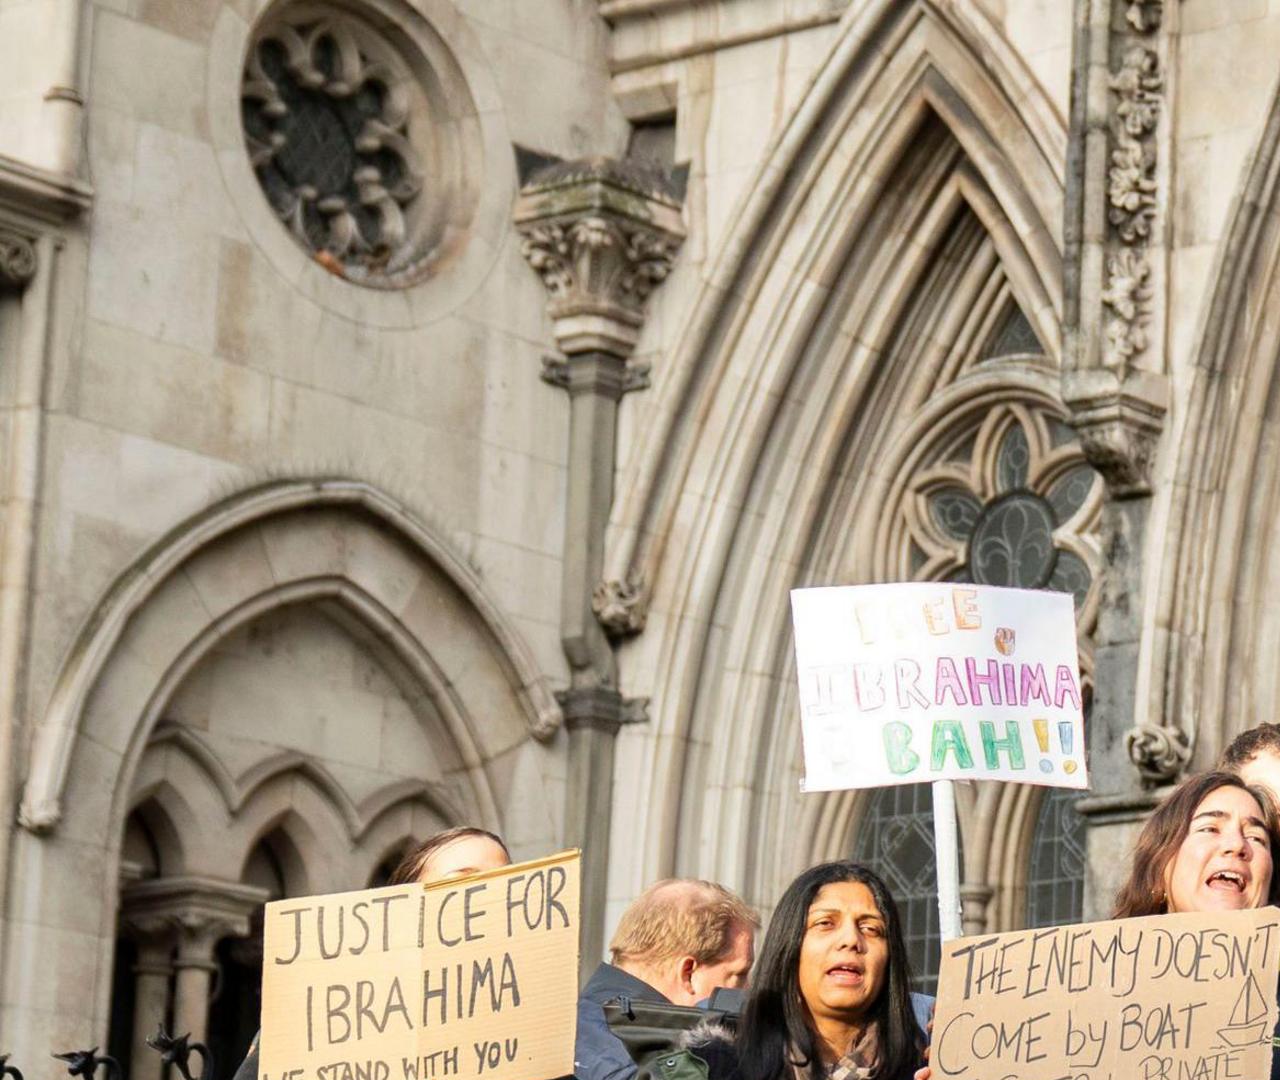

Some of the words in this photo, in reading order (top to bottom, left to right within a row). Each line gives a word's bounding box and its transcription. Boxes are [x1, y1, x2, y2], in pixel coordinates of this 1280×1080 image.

[853, 588, 982, 645] FEE
[806, 656, 1082, 716] IBRAHIMA
[882, 719, 1078, 775] BAH!!
[274, 883, 487, 966] JUSTICE
[506, 865, 570, 938] FOR
[951, 937, 1026, 1000] THE
[1022, 924, 1143, 998] ENEMY
[1150, 922, 1279, 983] DOESN'T
[306, 951, 521, 1052] IBRAHIMA
[937, 1010, 1052, 1076] COME
[1065, 1008, 1108, 1068] by
[1119, 1001, 1208, 1052] BOAT
